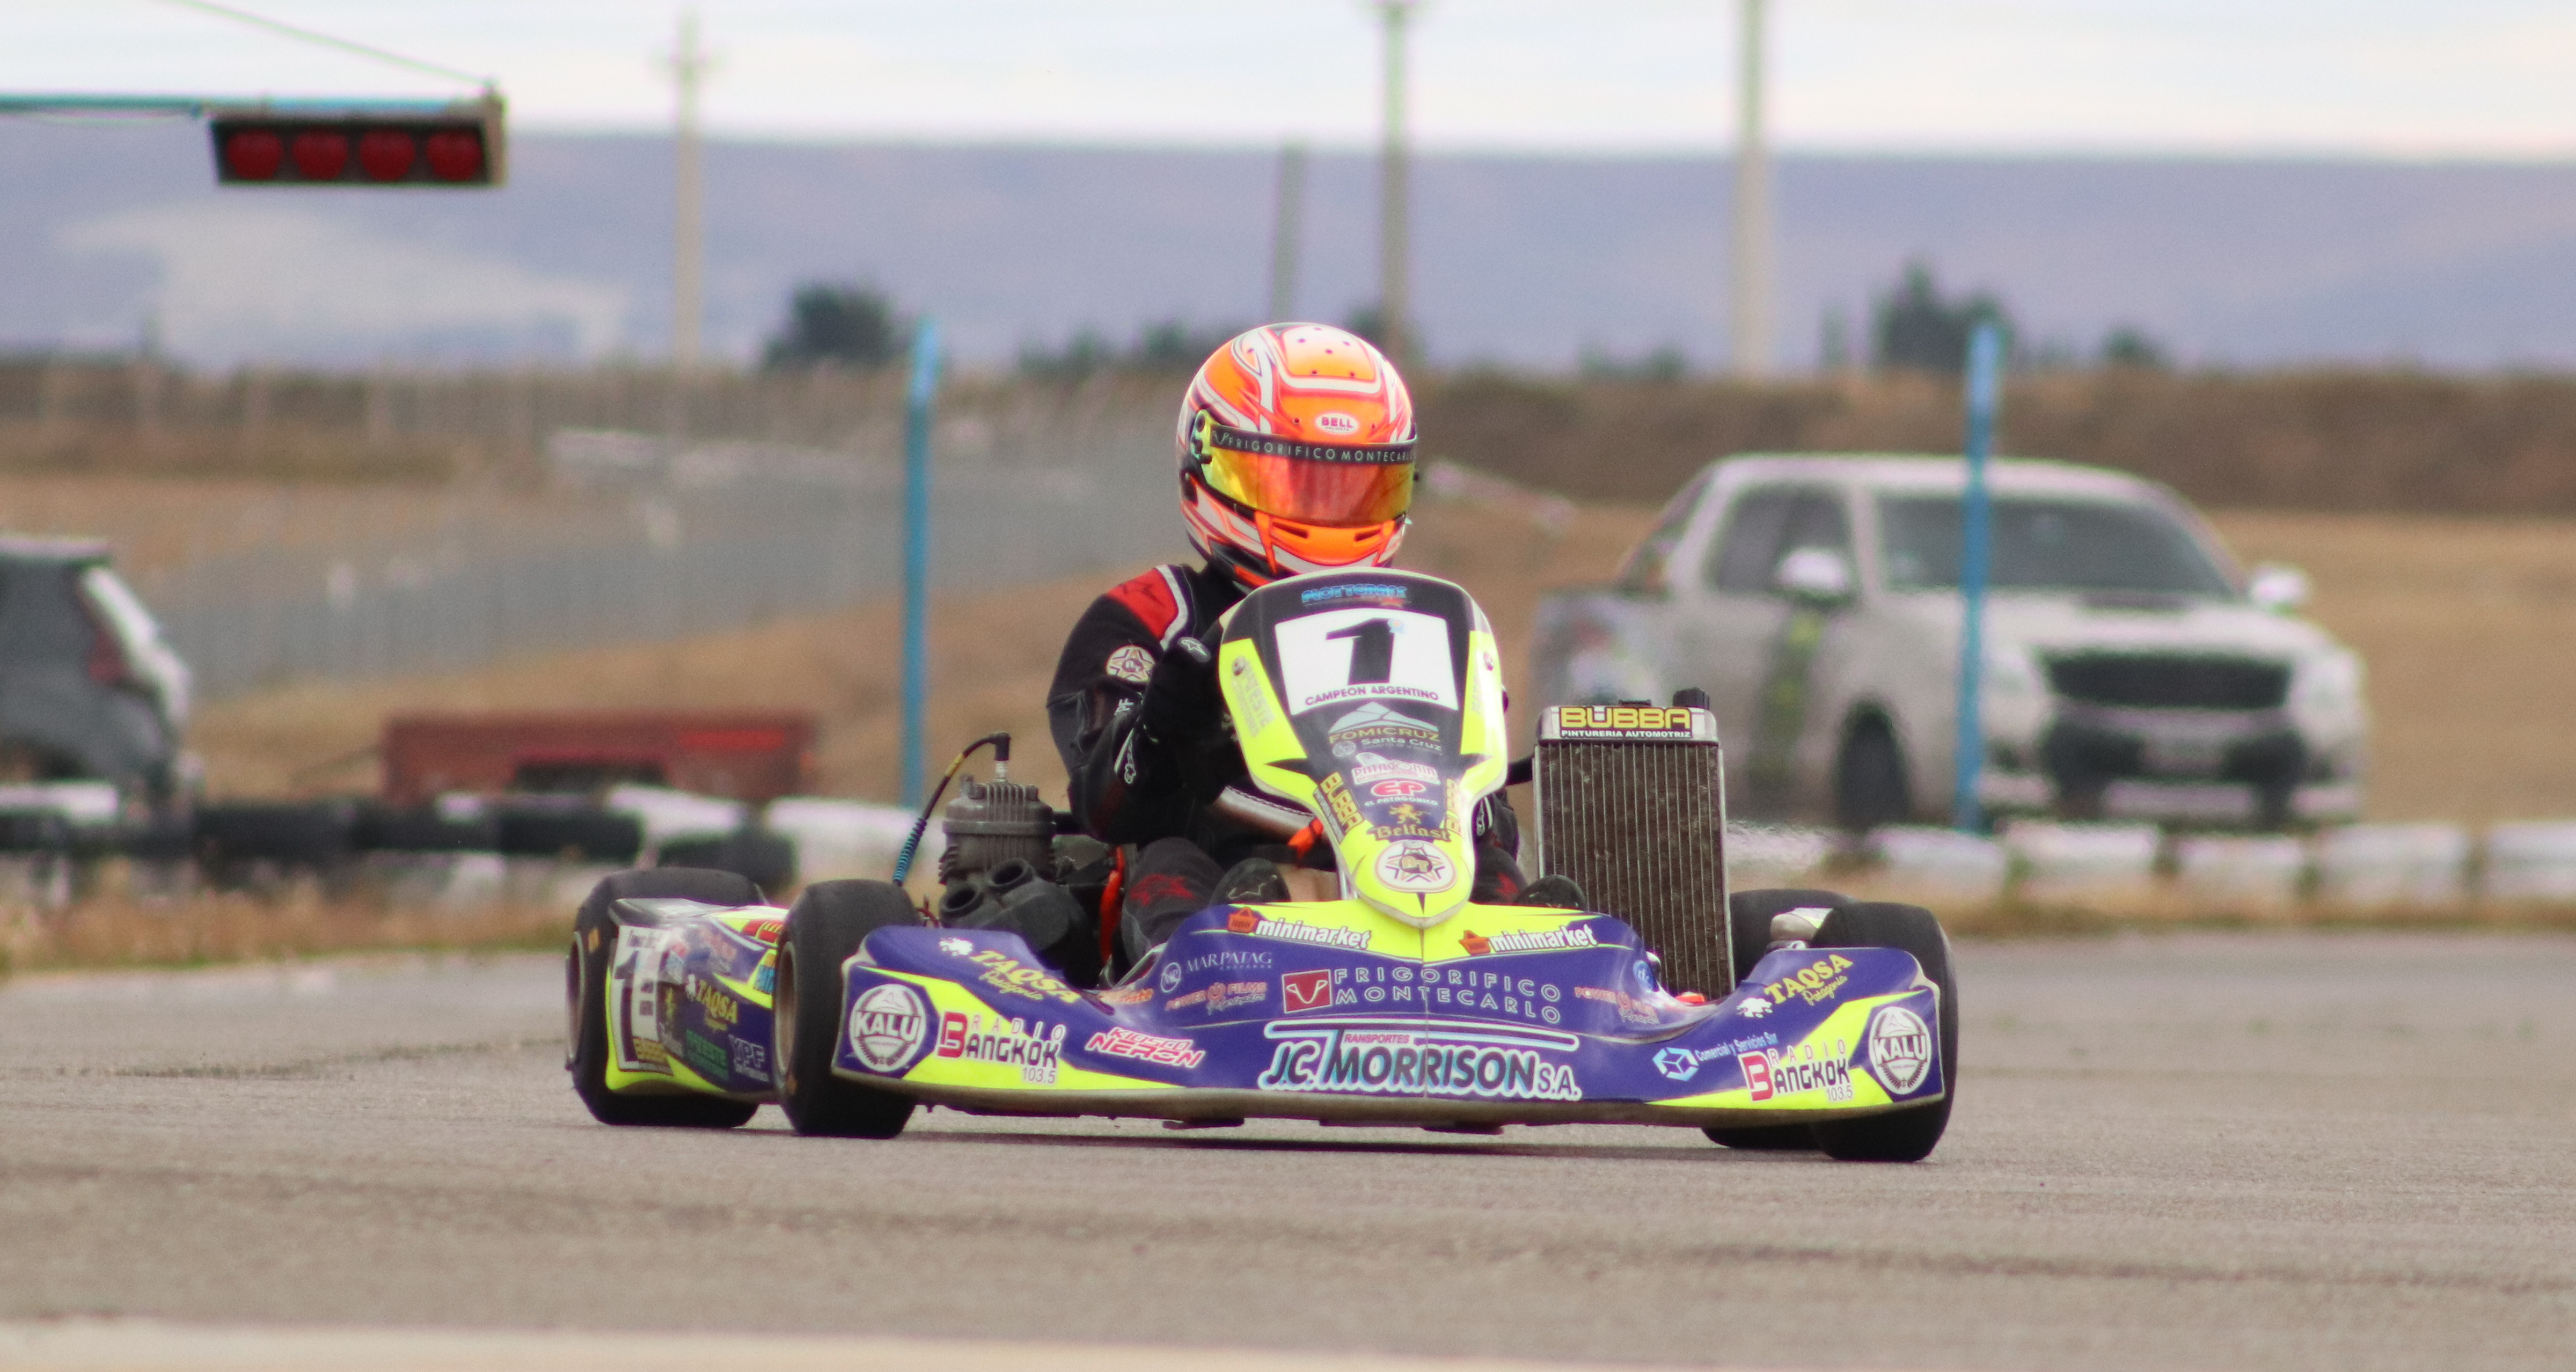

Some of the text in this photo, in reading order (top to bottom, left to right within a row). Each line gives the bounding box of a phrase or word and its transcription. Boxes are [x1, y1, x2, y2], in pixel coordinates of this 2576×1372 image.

[1321, 417, 1353, 429] BELL
[1228, 437, 1336, 460] FRIGORIFICO
[1326, 618, 1395, 686] 1
[1305, 686, 1439, 706] CAMPEON ARGENTINO
[1328, 727, 1440, 744] FOMICRUZ
[1361, 736, 1406, 746] Santa
[1409, 738, 1442, 751] Cruz
[1255, 917, 1372, 949] minimarket
[1488, 923, 1599, 952] minimarket
[1187, 951, 1272, 973] MARPATAG
[969, 950, 1081, 1004] TAQSA
[1334, 966, 1561, 1002] FRIGORIFICO
[1763, 954, 1854, 1004] TAQSA
[1802, 975, 1848, 1006] Patagonia
[1335, 986, 1561, 1024] MONTECARLO
[854, 1010, 920, 1041] KALU
[972, 1015, 1065, 1041] RADIO
[1087, 1033, 1205, 1067] NERON
[1695, 1042, 1730, 1062] Comercial
[1729, 1043, 1737, 1056] y
[1733, 1034, 1766, 1052] Servicios
[1767, 1039, 1845, 1065] RADIO
[1873, 1034, 1928, 1065] KALU
[1022, 1067, 1056, 1084] 103.5
[1322, 1045, 1537, 1094] MORRISON
[1537, 1066, 1580, 1097] S.A.
[1827, 1085, 1853, 1102] 103.5
